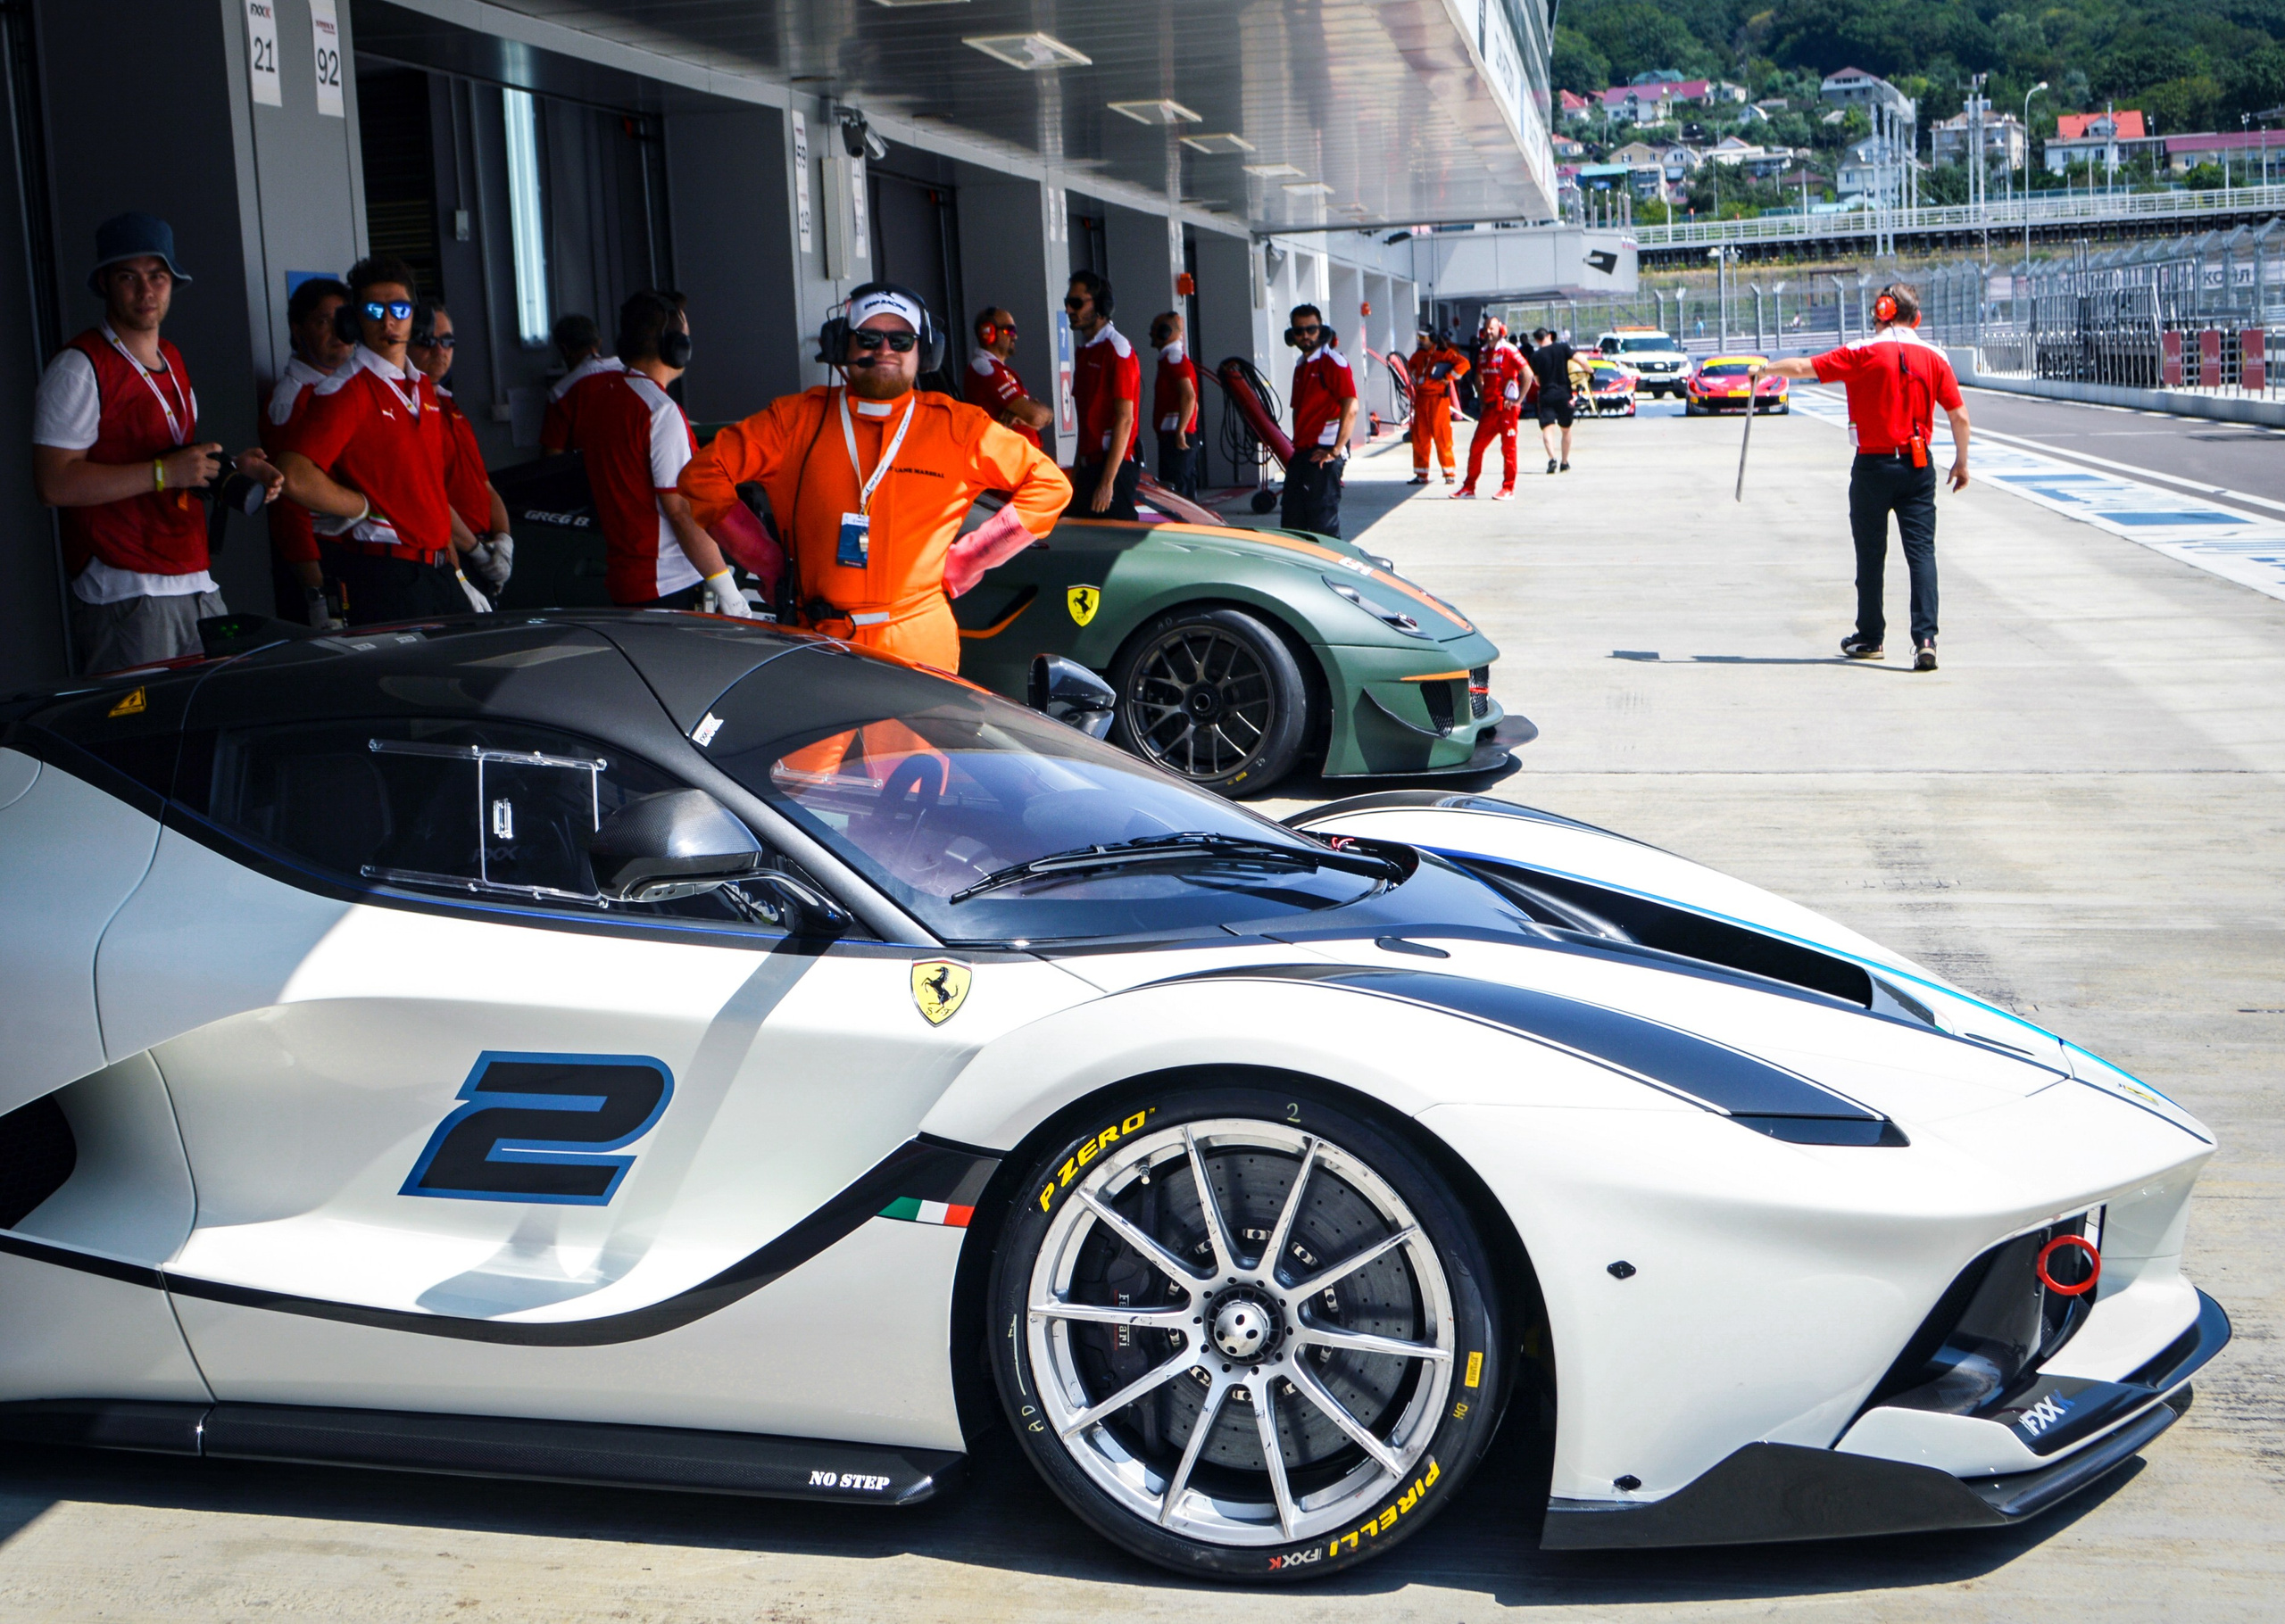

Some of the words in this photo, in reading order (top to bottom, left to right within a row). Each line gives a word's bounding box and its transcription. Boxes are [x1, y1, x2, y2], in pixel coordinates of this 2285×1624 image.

[253, 36, 275, 73] 21
[317, 47, 339, 87] 92
[914, 468, 945, 478] MARSHAL
[524, 510, 573, 525] GREG
[397, 1050, 675, 1206] 2
[1286, 1102, 1301, 1123] 2
[1039, 1182, 1055, 1213] P
[1057, 1110, 1147, 1188] ZERO
[1118, 1293, 1130, 1346] Feari
[809, 1471, 837, 1487] NO
[839, 1473, 890, 1490] STEP
[1329, 1456, 1442, 1557] PIRELLI
